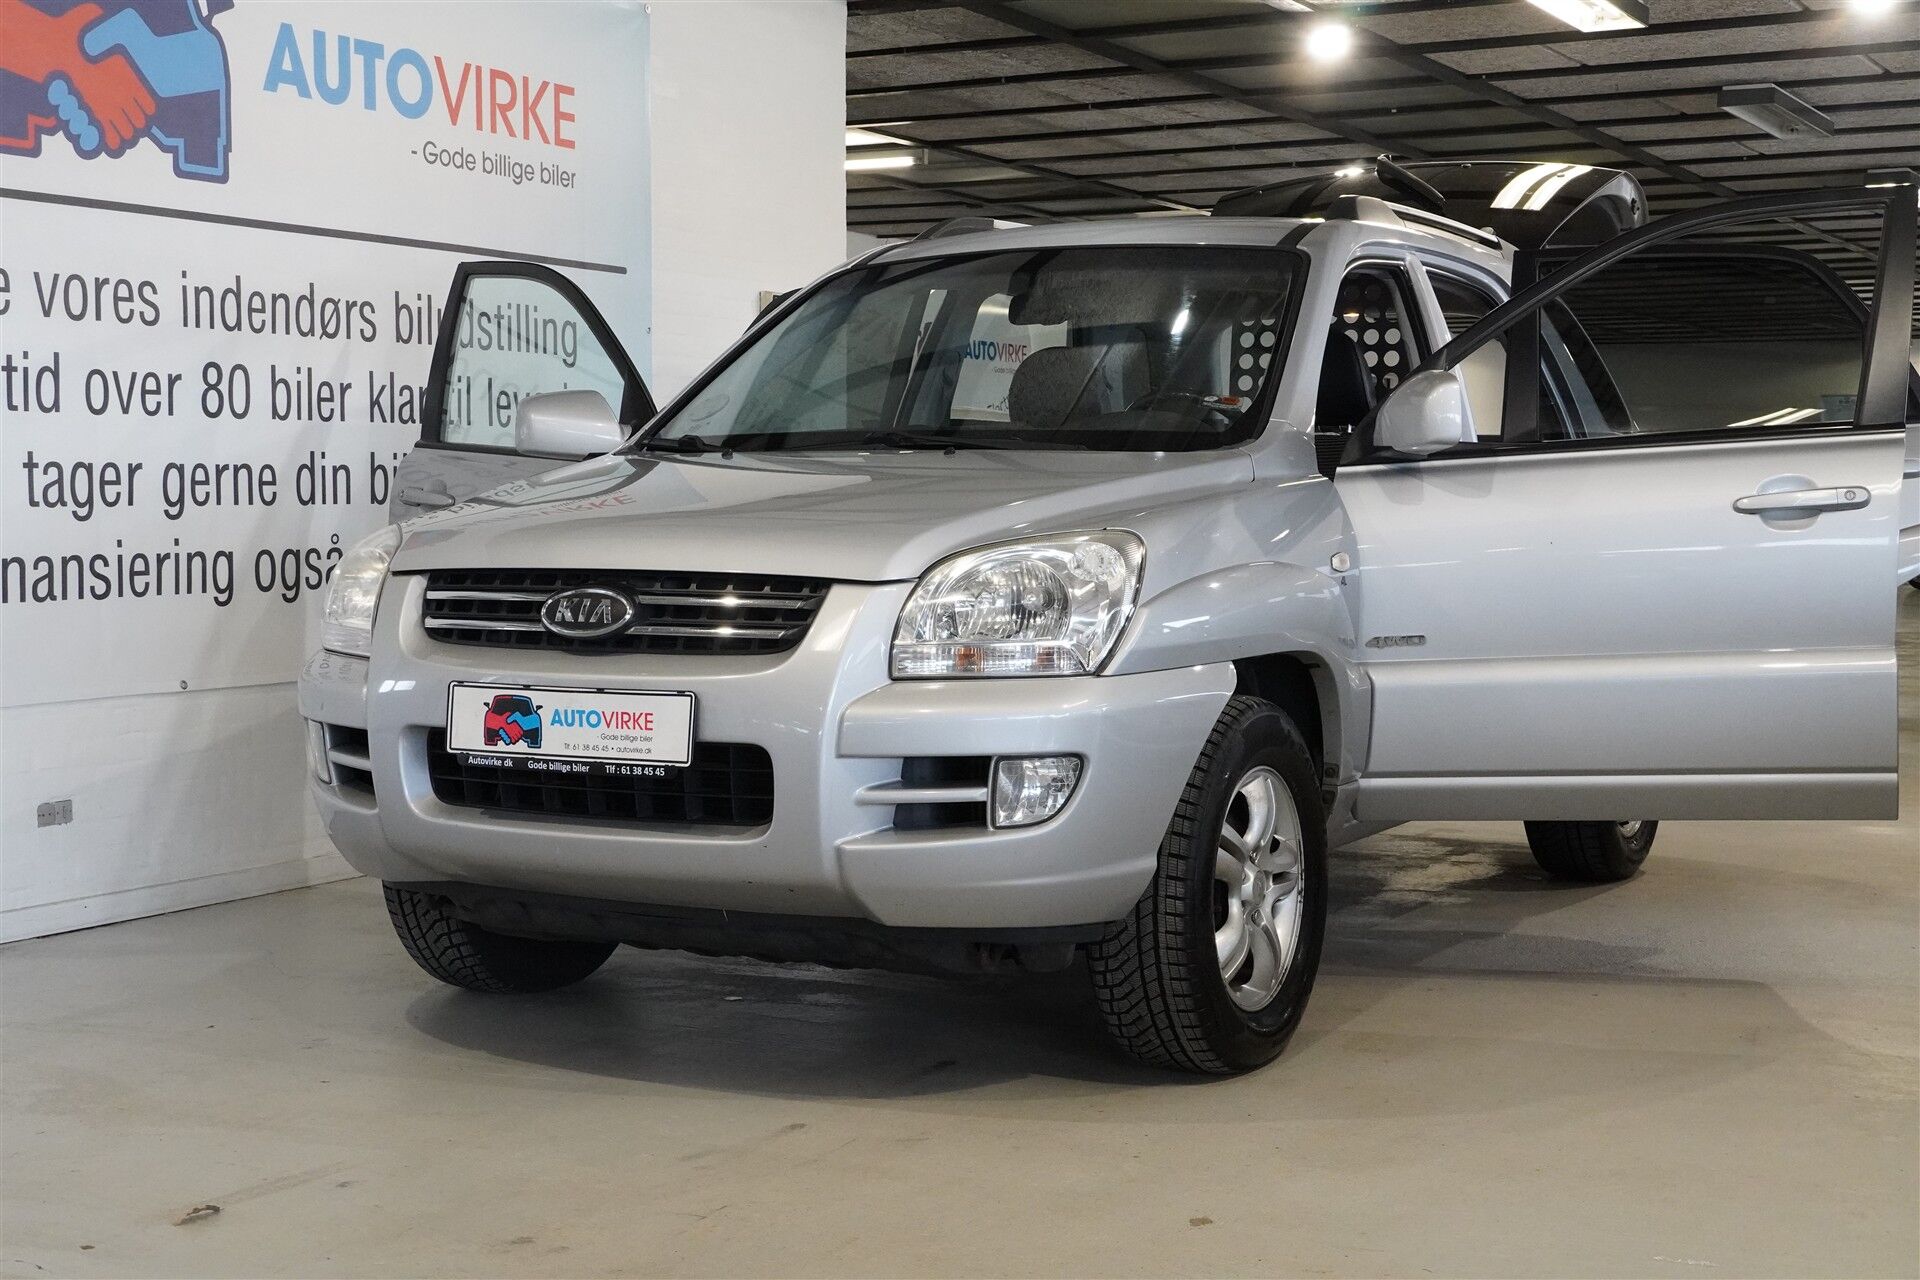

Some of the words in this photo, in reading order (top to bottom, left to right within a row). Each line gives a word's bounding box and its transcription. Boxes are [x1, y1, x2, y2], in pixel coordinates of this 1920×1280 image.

[263, 22, 576, 150] AUTOVIRKE
[423, 140, 477, 171] Gode
[482, 151, 535, 185] billige
[540, 162, 576, 189] biler
[33, 271, 161, 327] vores
[181, 270, 377, 343] indendørs
[85, 368, 182, 416] over
[201, 361, 251, 420] 80
[270, 364, 352, 422] biler
[22, 451, 143, 522] tager
[163, 461, 277, 520] gerne
[296, 451, 351, 506] din
[554, 598, 613, 625] KIA
[1365, 635, 1426, 648] 4WD
[550, 708, 654, 731] AUTOVIRKE
[600, 733, 619, 742] Gode
[639, 734, 653, 742] biler
[468, 756, 502, 768] Autovirke
[504, 758, 513, 768] dk
[527, 760, 547, 770] Gode
[549, 761, 571, 773] billige
[572, 762, 590, 773] biler
[621, 765, 631, 775] 61
[632, 766, 643, 776] 38
[643, 767, 654, 776] 45
[654, 767, 665, 777] 45
